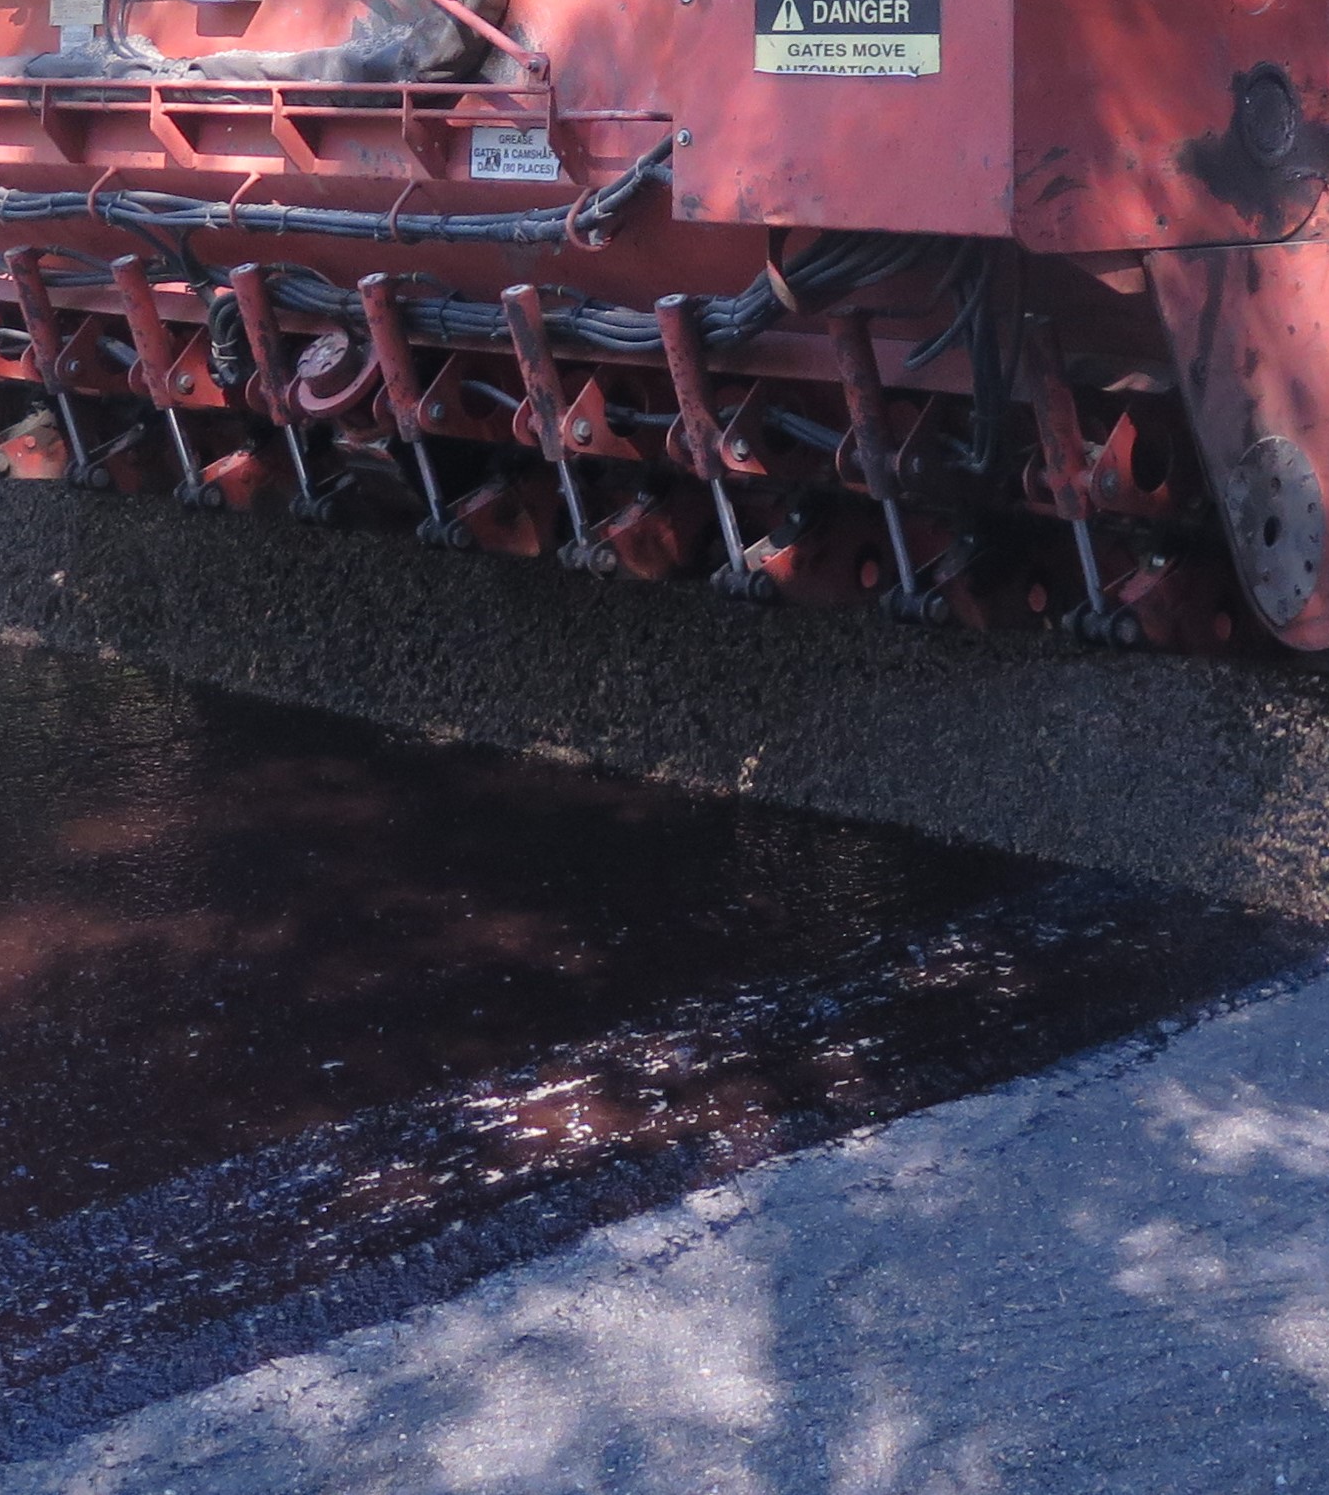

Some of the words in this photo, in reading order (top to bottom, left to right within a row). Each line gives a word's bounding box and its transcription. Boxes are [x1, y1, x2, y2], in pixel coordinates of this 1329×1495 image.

[812, 0, 910, 24] DANGER
[787, 43, 847, 58] GATES
[852, 43, 906, 57] MOVE
[498, 134, 533, 145] GREASE
[473, 147, 501, 158] GATES
[517, 163, 555, 176] PLACES)
